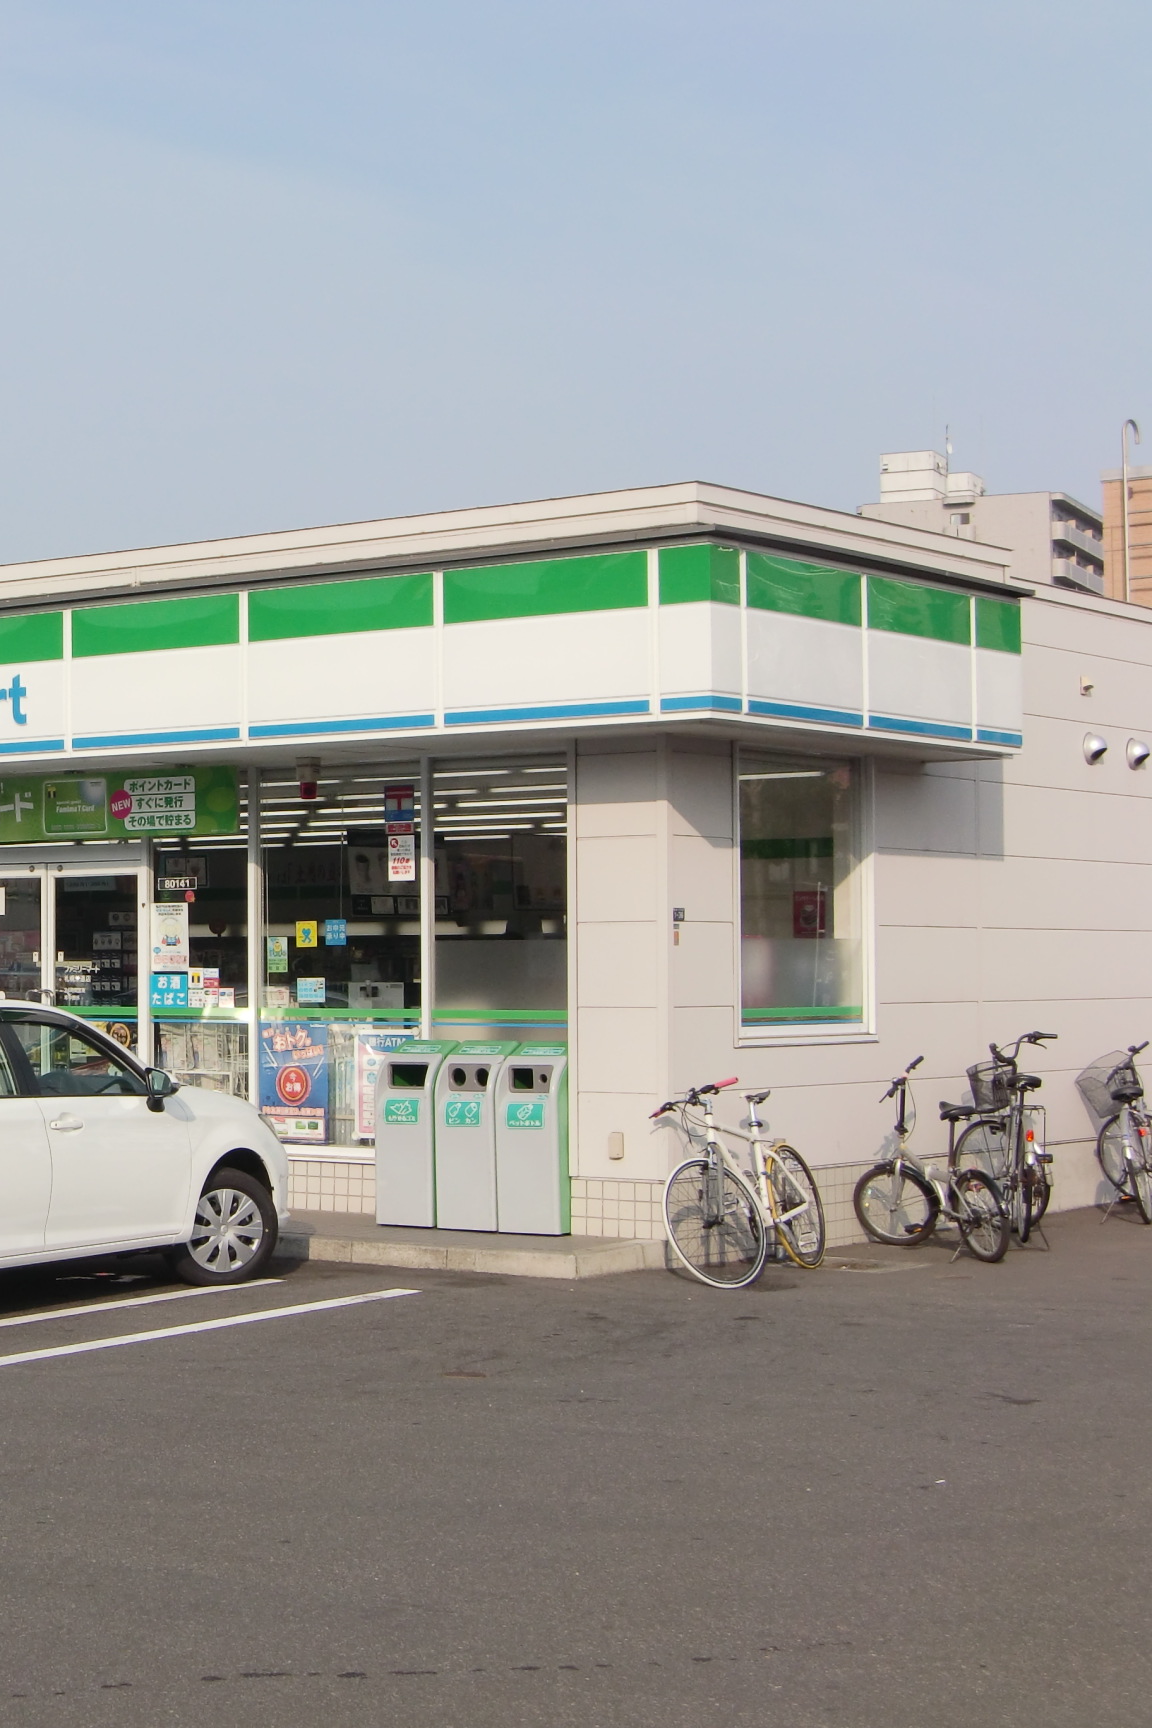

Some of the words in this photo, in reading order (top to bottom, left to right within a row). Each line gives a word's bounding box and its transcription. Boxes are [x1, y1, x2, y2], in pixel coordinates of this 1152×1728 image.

[128, 778, 192, 793] ポイントカード
[111, 797, 131, 812] NEW
[135, 795, 184, 809] すぐに発行
[128, 814, 192, 828] その場で貯まる
[165, 879, 190, 889] 80141
[158, 976, 181, 990] お酒
[152, 992, 186, 1006] たばこ
